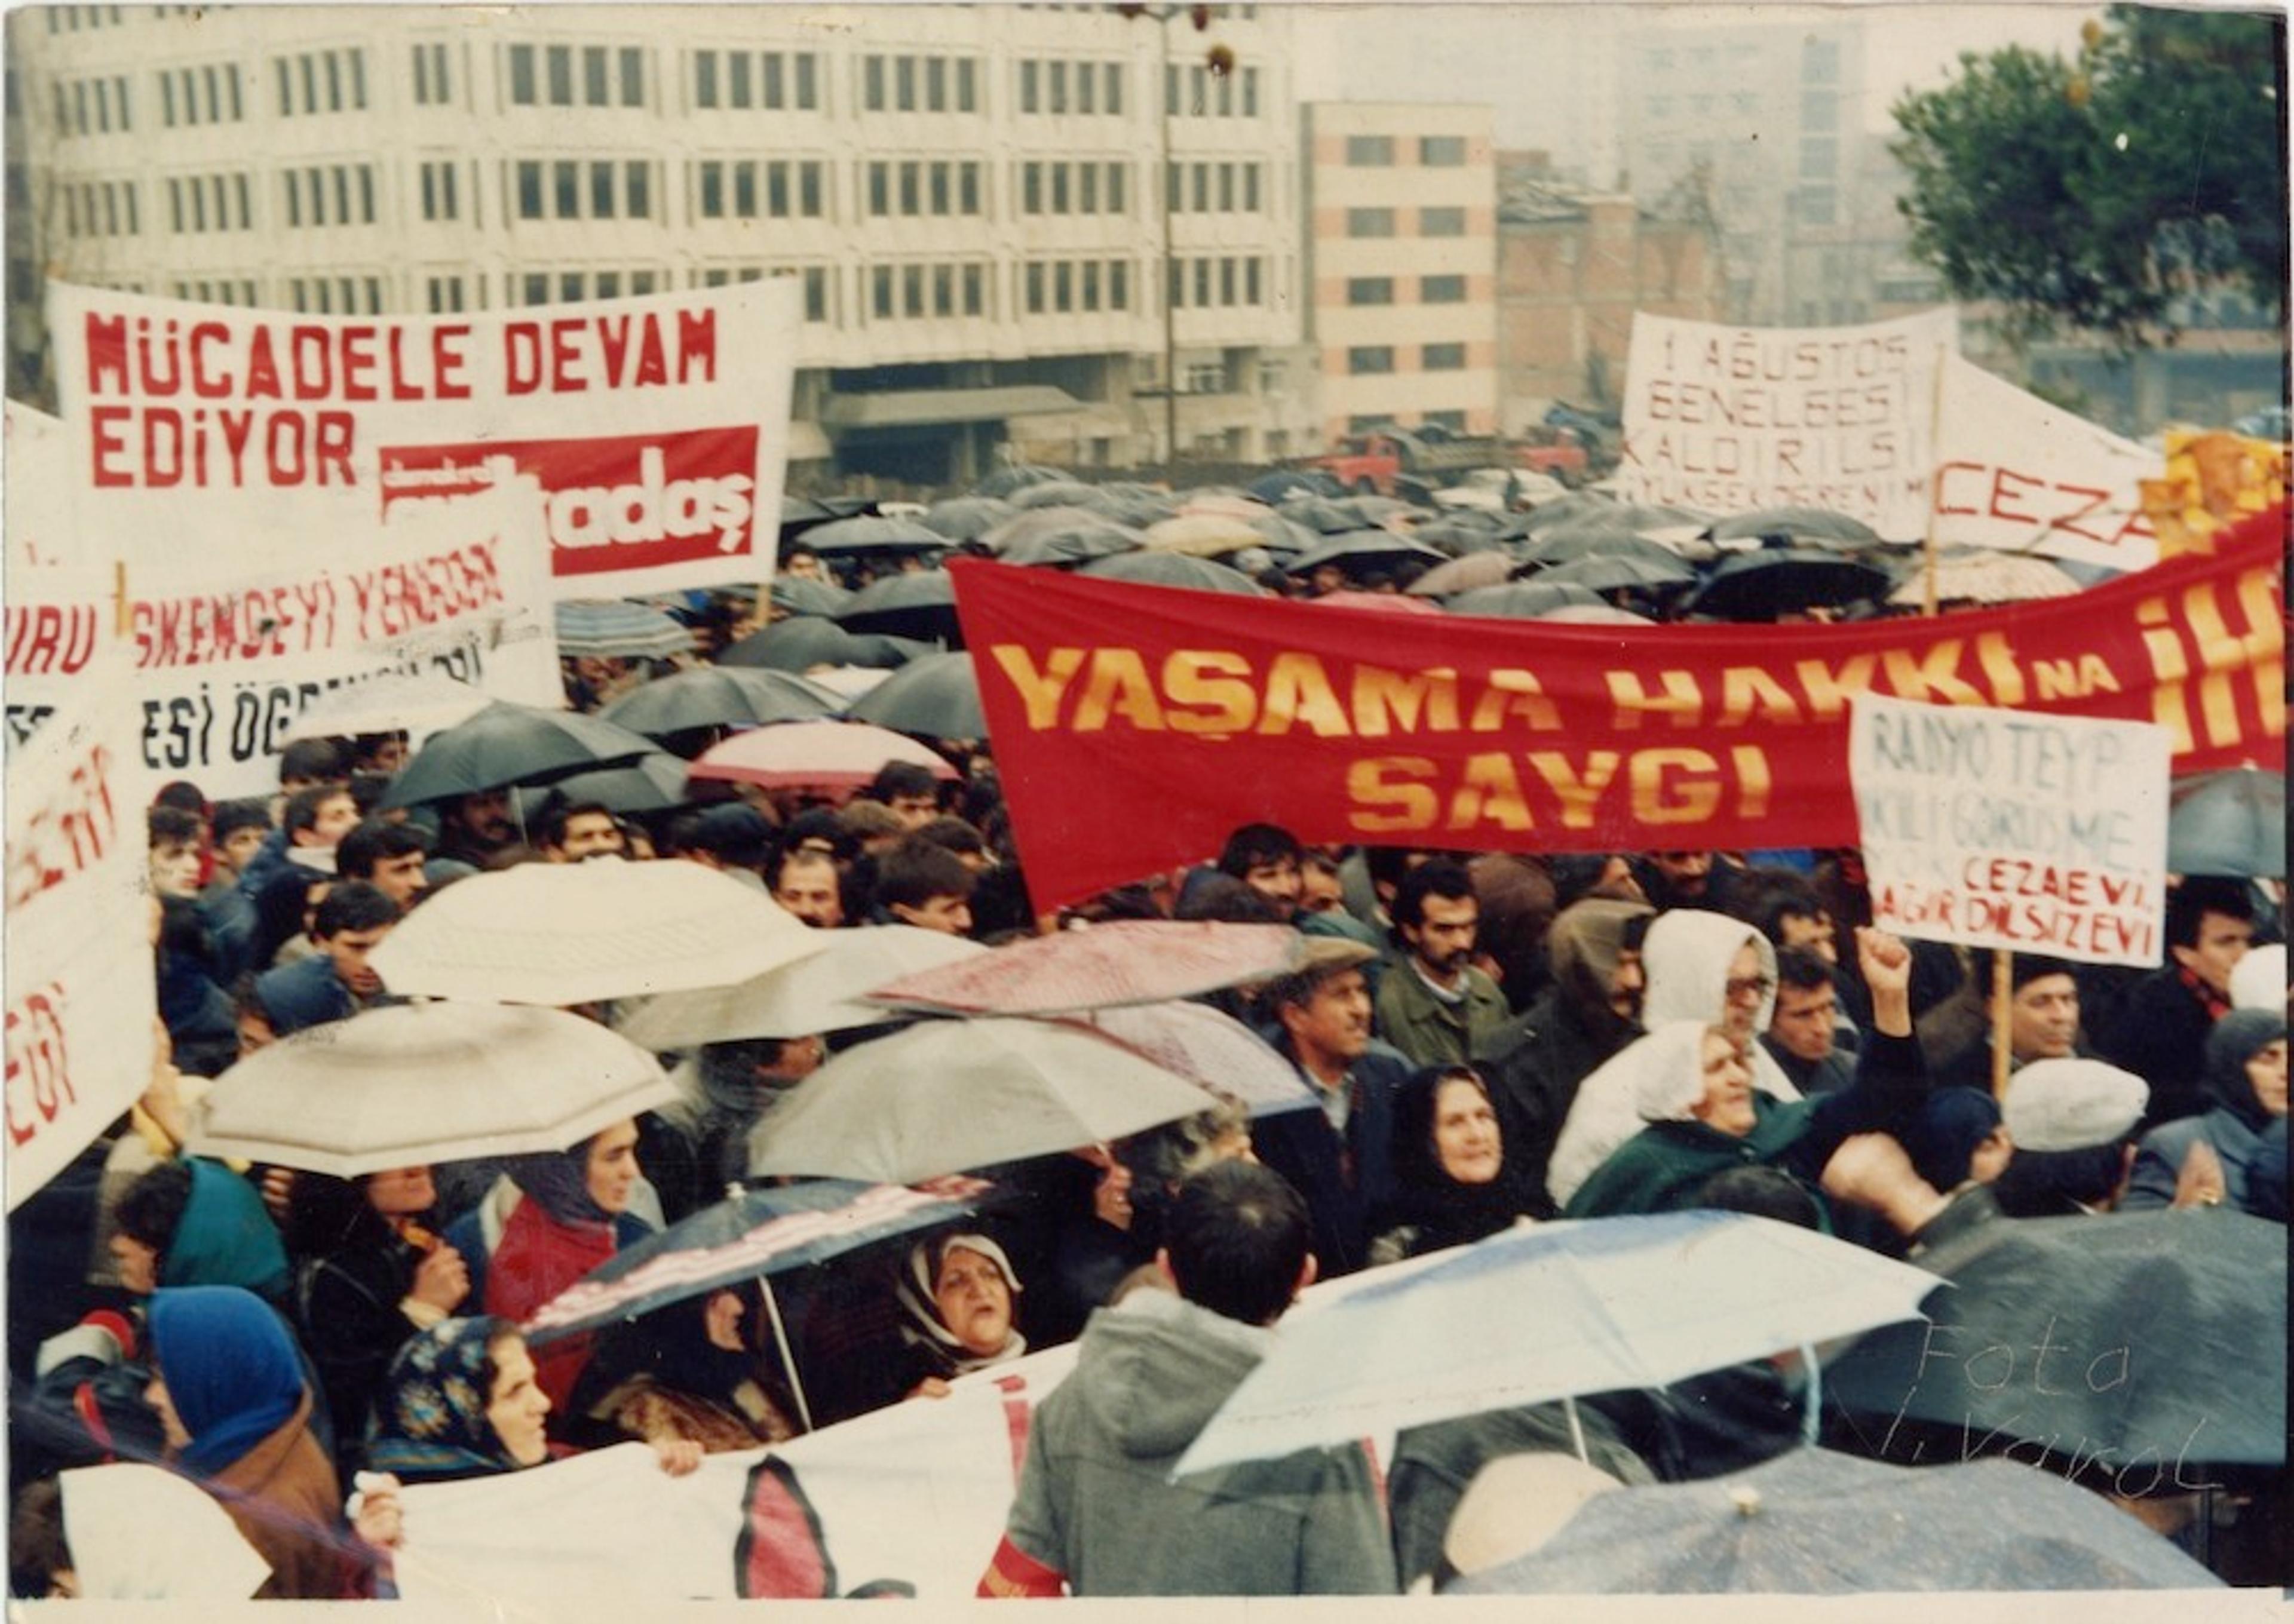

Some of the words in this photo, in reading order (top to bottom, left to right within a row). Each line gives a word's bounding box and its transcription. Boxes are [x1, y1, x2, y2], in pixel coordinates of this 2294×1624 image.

[85, 312, 472, 400] MÜCADELE
[505, 308, 716, 395] DEVAM
[90, 406, 357, 488] EDİYOR
[990, 643, 1562, 742] YAŞAMA
[1347, 744, 1772, 831] SAYGI
[1872, 711, 1991, 782] RADYO
[2003, 720, 2126, 805] TEYP
